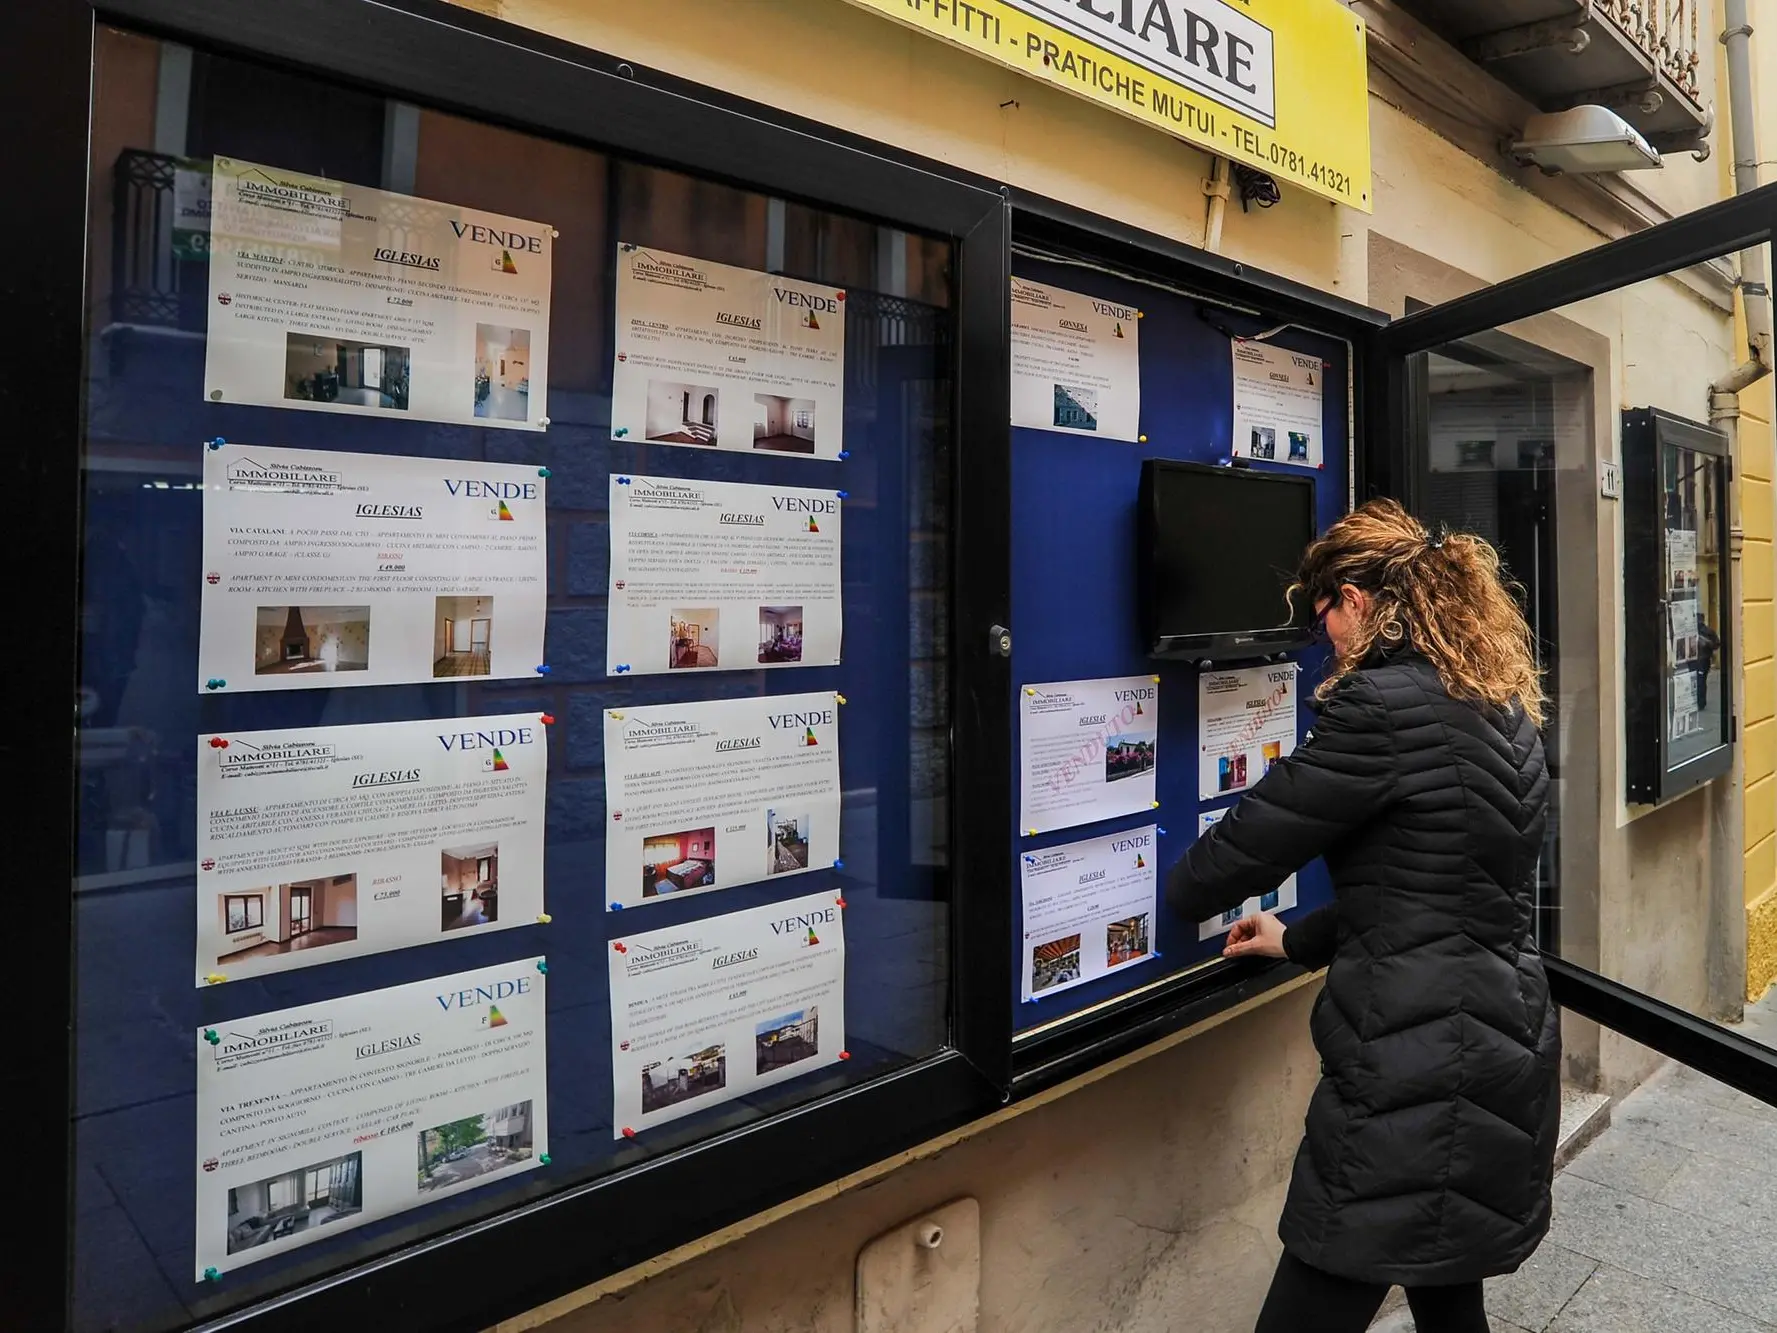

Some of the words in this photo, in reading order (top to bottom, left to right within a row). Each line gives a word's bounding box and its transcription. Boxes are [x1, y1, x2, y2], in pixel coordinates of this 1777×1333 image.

[1026, 32, 1144, 107] PRATICHE
[1153, 89, 1214, 137] MUTUI
[1232, 125, 1350, 196] TEL.0781.41321
[246, 181, 346, 208] IMMOBILIARE
[448, 220, 542, 254] VENDE
[373, 246, 439, 268] IGLESIAS
[637, 261, 703, 281] IMMOBILIARE
[774, 287, 836, 313] VENDE
[716, 311, 760, 328] IGLESIAS
[1092, 301, 1132, 321] VENDE
[1291, 356, 1319, 371] VENDE
[235, 469, 336, 482] IMMOBILIARE
[443, 478, 536, 499] VENDE
[634, 489, 700, 499] IMMOBILIARE
[356, 504, 422, 516] IGLESIAS
[772, 496, 834, 513] VENDE
[720, 513, 764, 523] IGLESIAS
[1267, 671, 1294, 683] VENDE
[1115, 688, 1154, 701] VENDE
[767, 710, 831, 730] VENDE
[437, 727, 533, 752] VENDE
[628, 724, 696, 737] IMMOBILIARE
[715, 736, 760, 750] IGLESIAS
[228, 747, 330, 762] IMMOBILIARE
[352, 768, 420, 785] IGLESIAS
[1111, 835, 1150, 853] VENDE
[770, 907, 834, 936] VENDE
[630, 942, 698, 964] IMMOBILIARE
[712, 946, 758, 967] IGLESIAS
[436, 976, 530, 1013] VENDE
[224, 1023, 327, 1054] IMMOBILIARE
[356, 1032, 421, 1058] IGLESIAS
[220, 1105, 234, 1113] VIA
